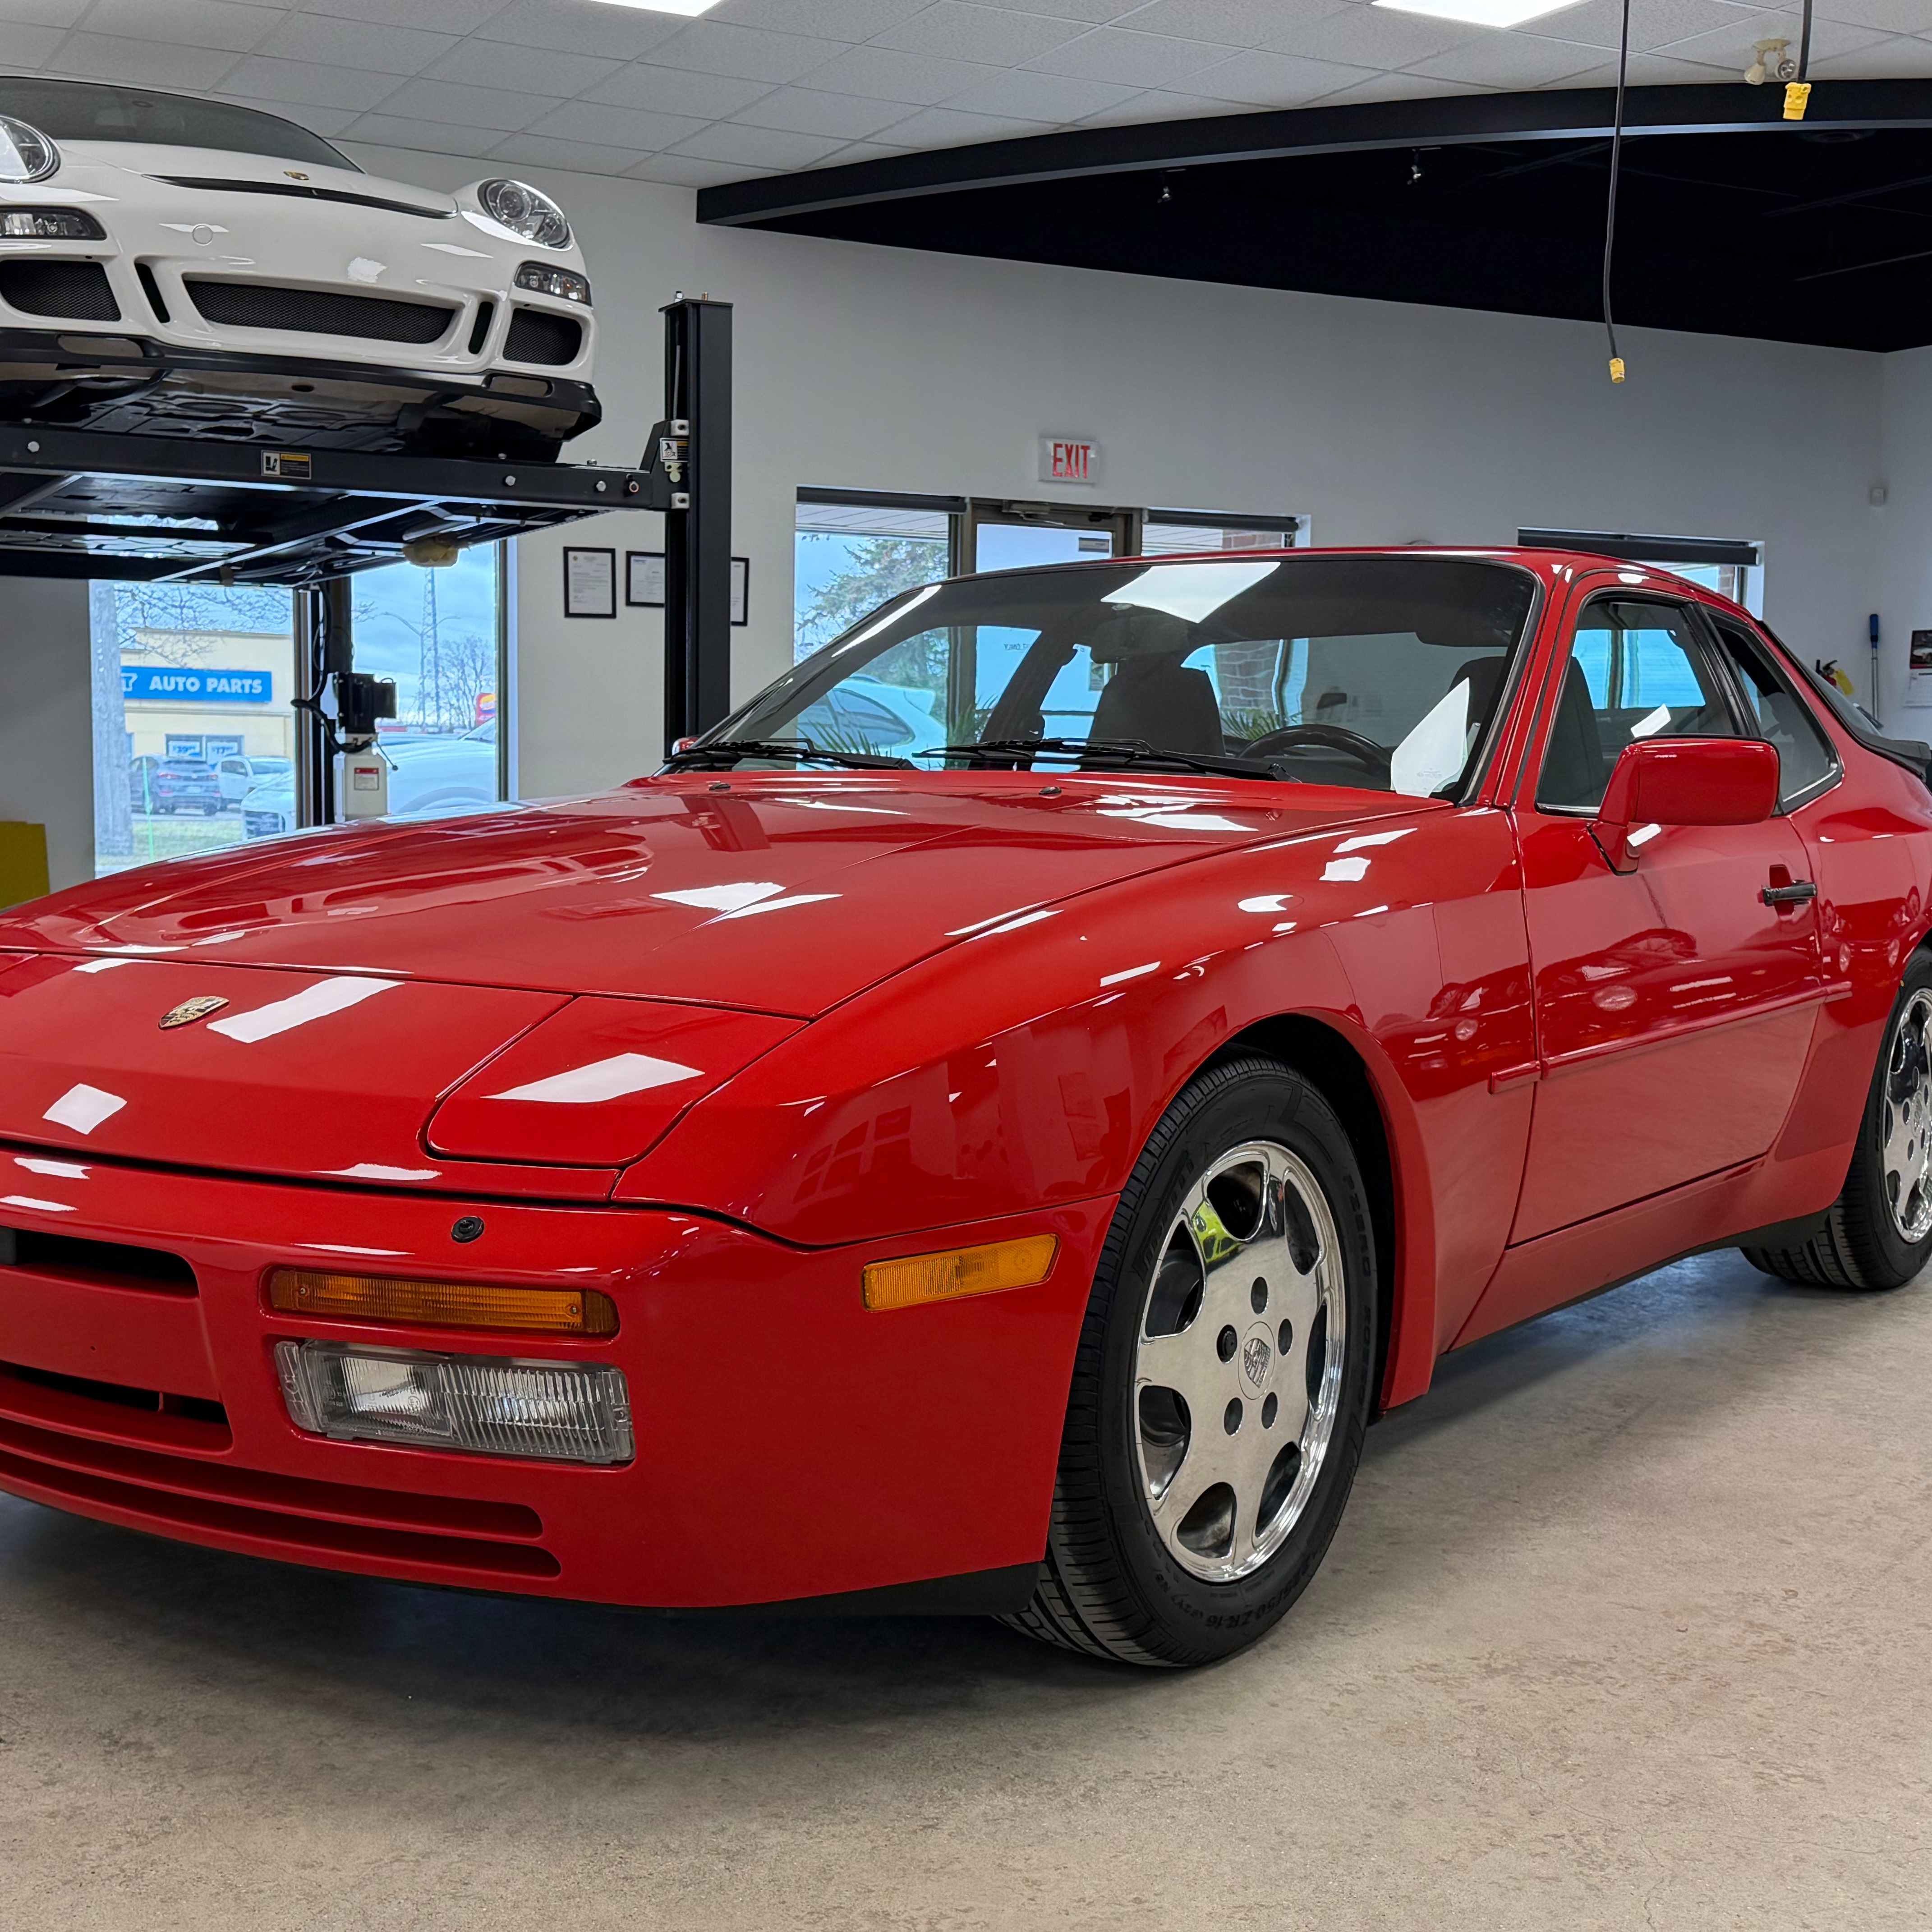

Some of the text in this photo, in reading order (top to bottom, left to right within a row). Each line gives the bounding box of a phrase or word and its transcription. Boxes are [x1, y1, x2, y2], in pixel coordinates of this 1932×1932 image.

[1053, 443, 1090, 478] EXIT
[149, 676, 200, 692] AUTO
[206, 677, 262, 694] PARTS
